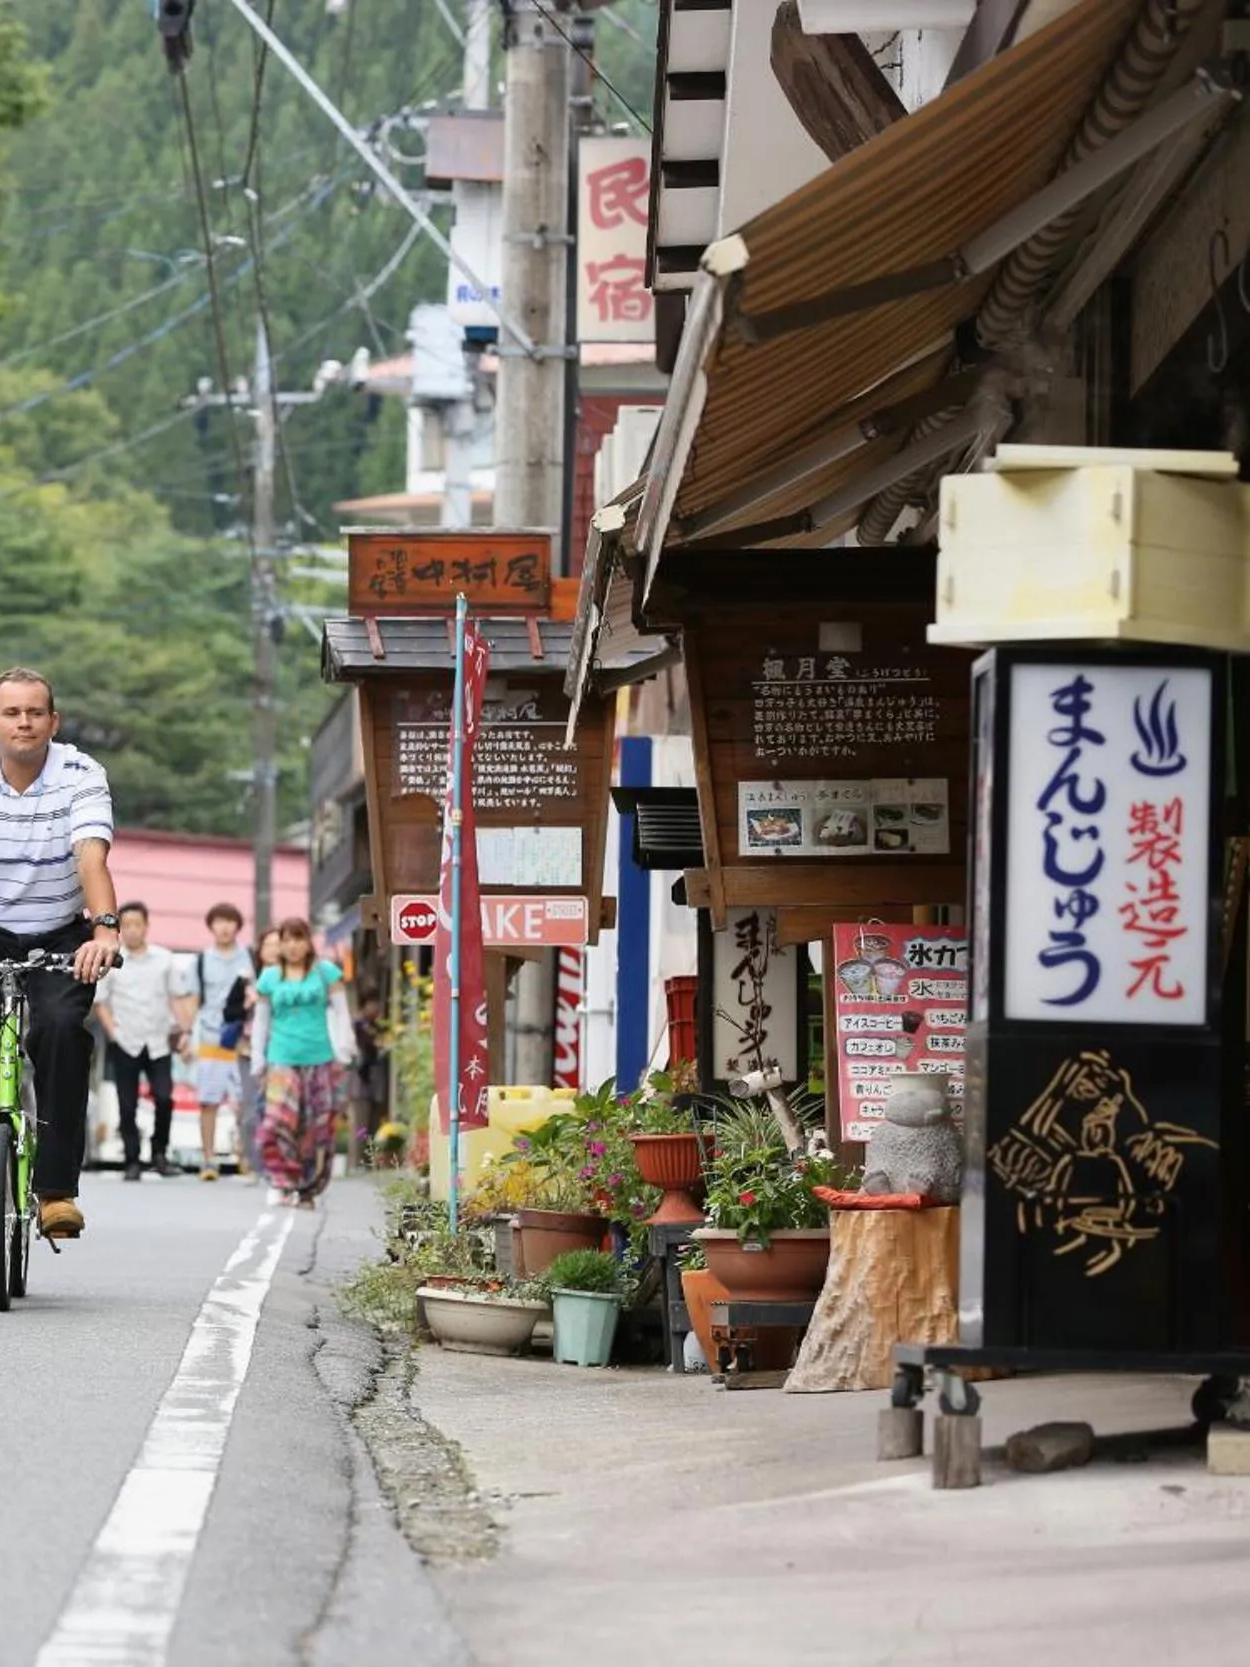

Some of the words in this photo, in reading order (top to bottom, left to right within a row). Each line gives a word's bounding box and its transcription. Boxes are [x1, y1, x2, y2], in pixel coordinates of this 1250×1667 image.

[584, 156, 651, 324] 民宿
[1036, 673, 1108, 1007] まんじゅう
[400, 914, 436, 929] STOP
[1118, 796, 1188, 1001] 製造元
[844, 1016, 901, 1030] アイスコーヒー
[911, 980, 934, 997] 氷
